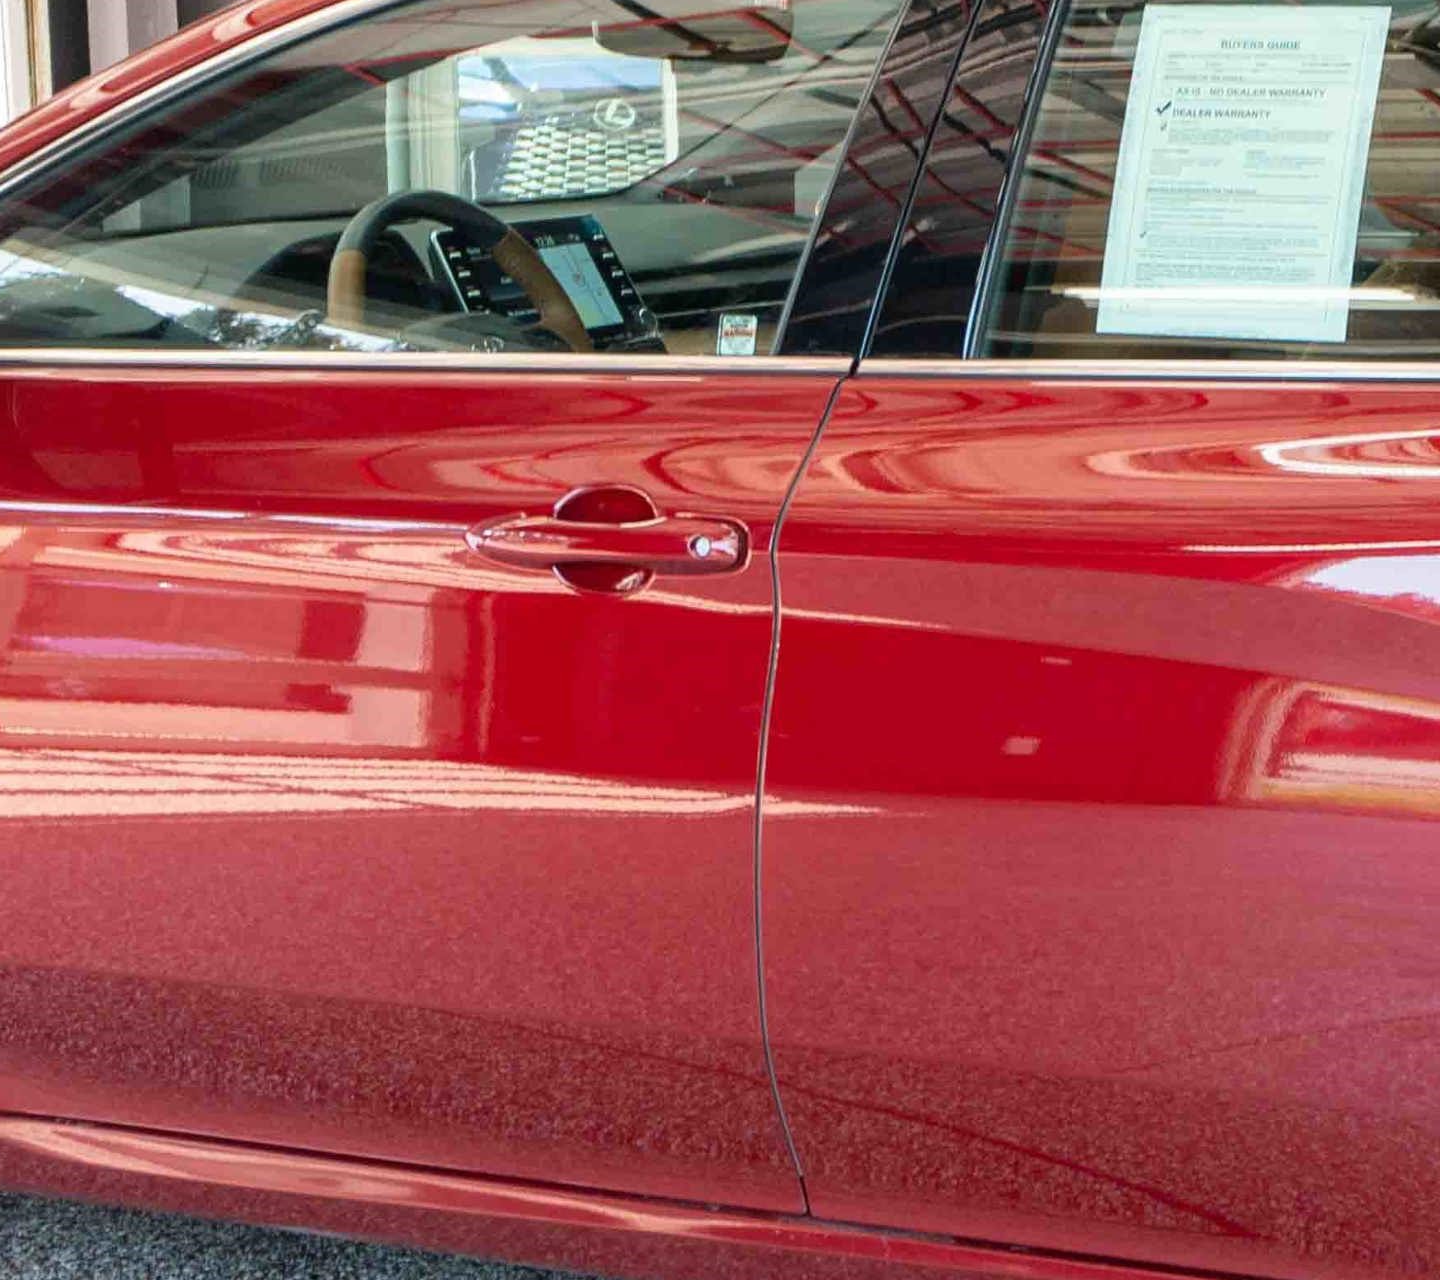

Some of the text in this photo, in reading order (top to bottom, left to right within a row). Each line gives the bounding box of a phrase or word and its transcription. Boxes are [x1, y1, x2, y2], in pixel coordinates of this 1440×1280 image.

[1267, 40, 1301, 50] GUIDE
[1268, 87, 1327, 98] WARRANTY
[1214, 108, 1272, 119] WARRANTY
